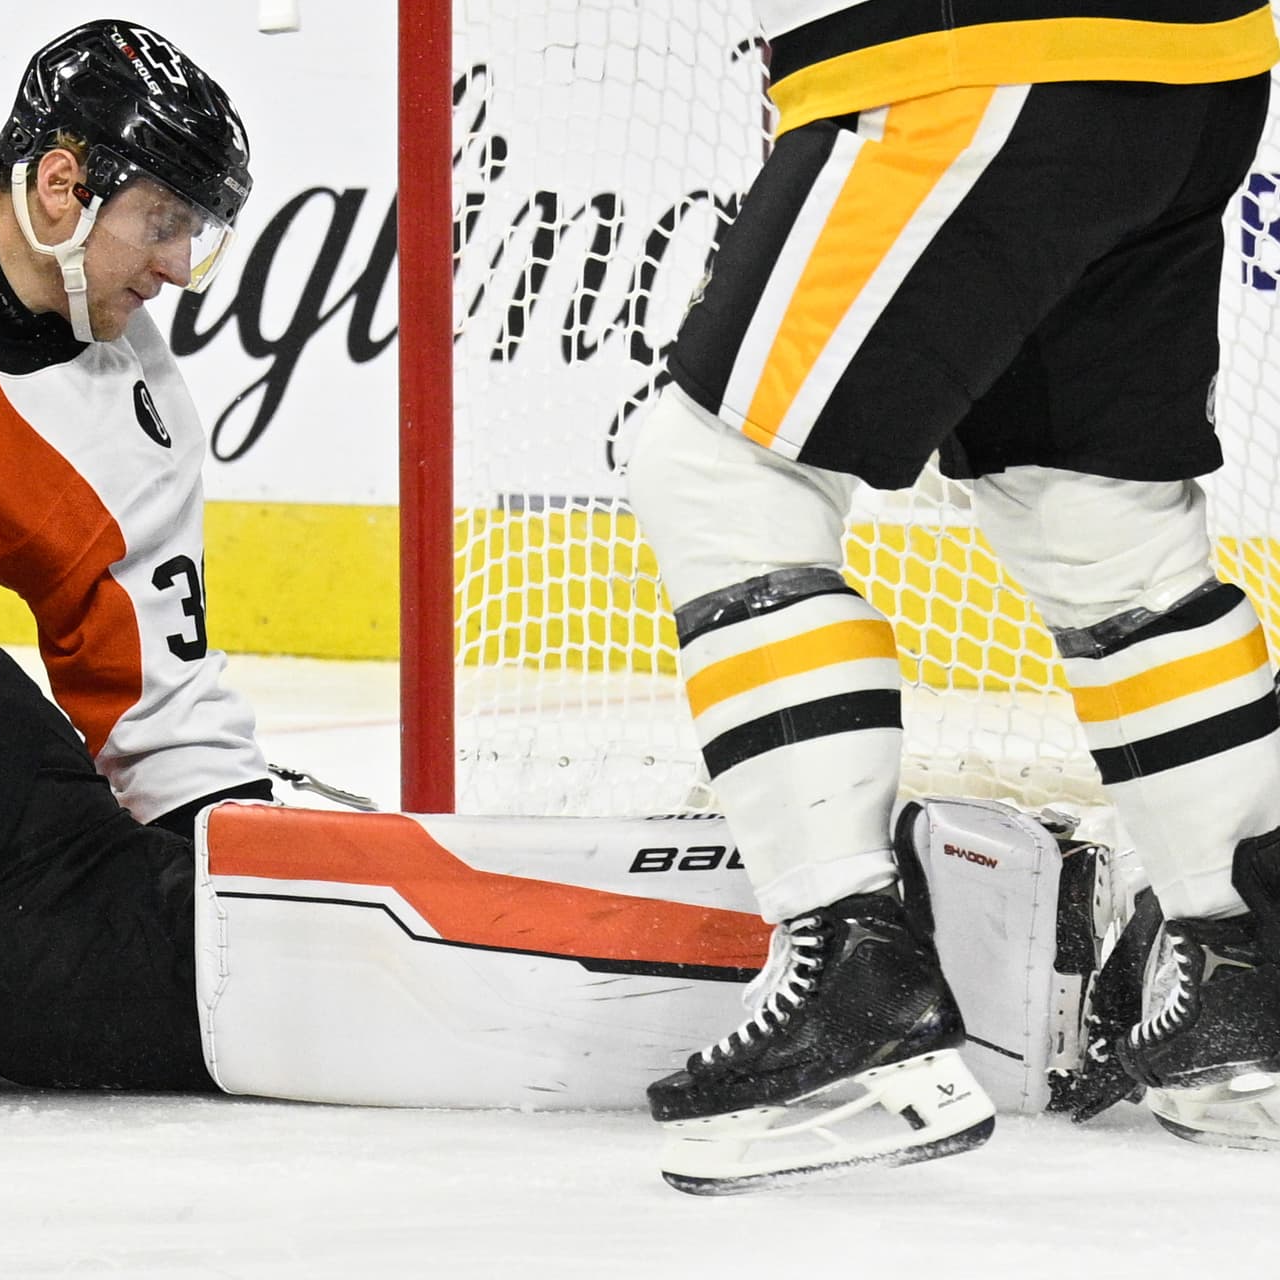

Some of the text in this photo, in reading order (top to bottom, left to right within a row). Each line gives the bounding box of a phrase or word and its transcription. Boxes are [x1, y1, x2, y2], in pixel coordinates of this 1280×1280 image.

[110, 30, 163, 96] CHEVROLET
[151, 554, 208, 663] 3
[943, 843, 999, 870] SHADOW
